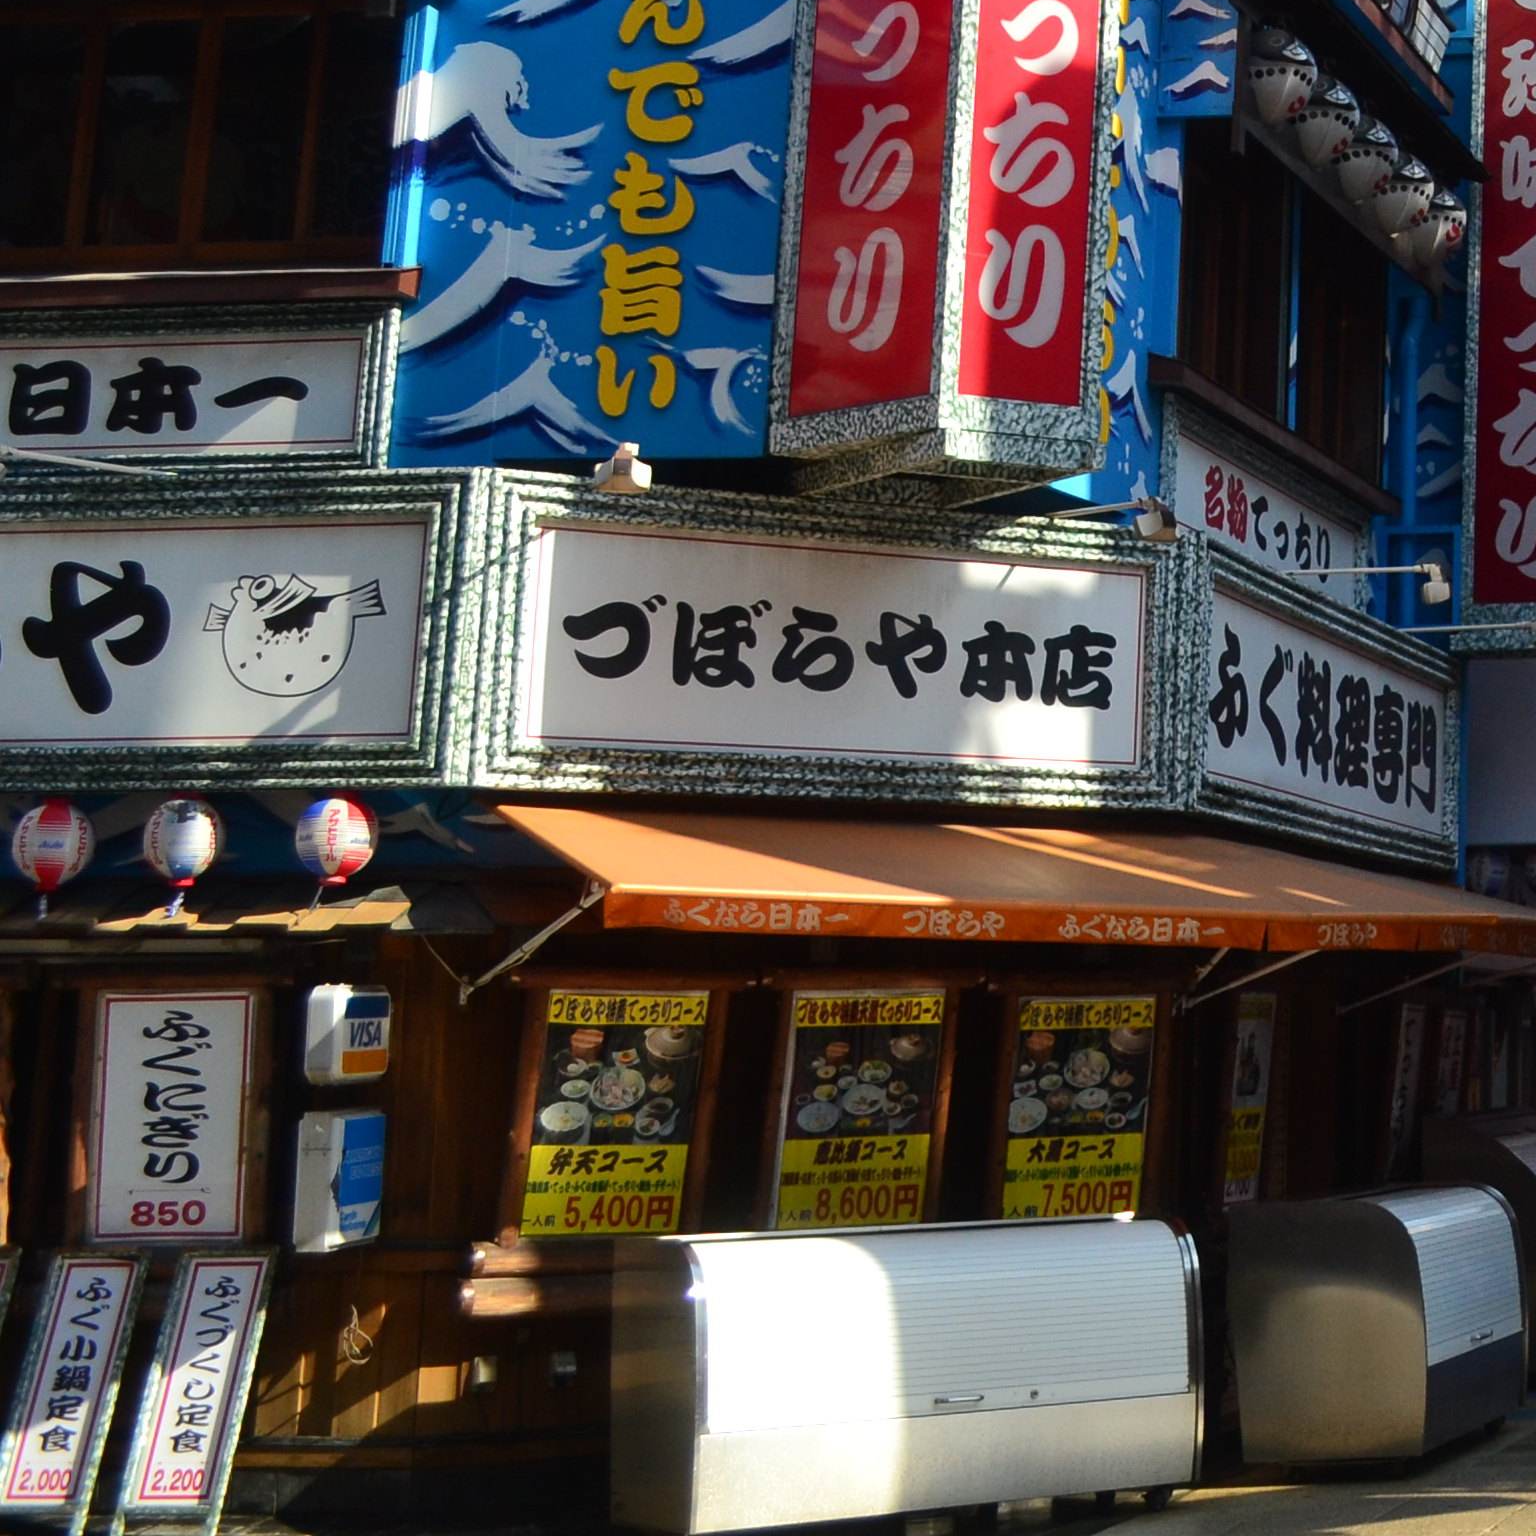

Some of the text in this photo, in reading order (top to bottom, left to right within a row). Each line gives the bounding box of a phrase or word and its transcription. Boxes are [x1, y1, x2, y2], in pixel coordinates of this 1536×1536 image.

[8, 357, 309, 434] 日本一
[22, 559, 171, 715] や
[562, 594, 1118, 711] づぼらや本店
[1208, 623, 1438, 814] ふぐ料理専門
[663, 900, 1377, 945] ふぐなら日本一 づぼらや ふぐなら日本一 づぼらや
[349, 1021, 383, 1048] VISA
[142, 1010, 212, 1183] ふぐにぎり
[547, 1148, 668, 1176] 弁天コース
[130, 1199, 207, 1227] 850
[564, 1194, 676, 1231] 5,400円
[815, 1184, 921, 1223] 8,600円
[1042, 1180, 1133, 1215] 7,500円
[40, 1277, 112, 1454] ふぐ小鍋定食
[170, 1275, 242, 1454] ふぐづくし定食
[18, 1468, 73, 1492] 2,000
[151, 1468, 205, 1492] 2,200
